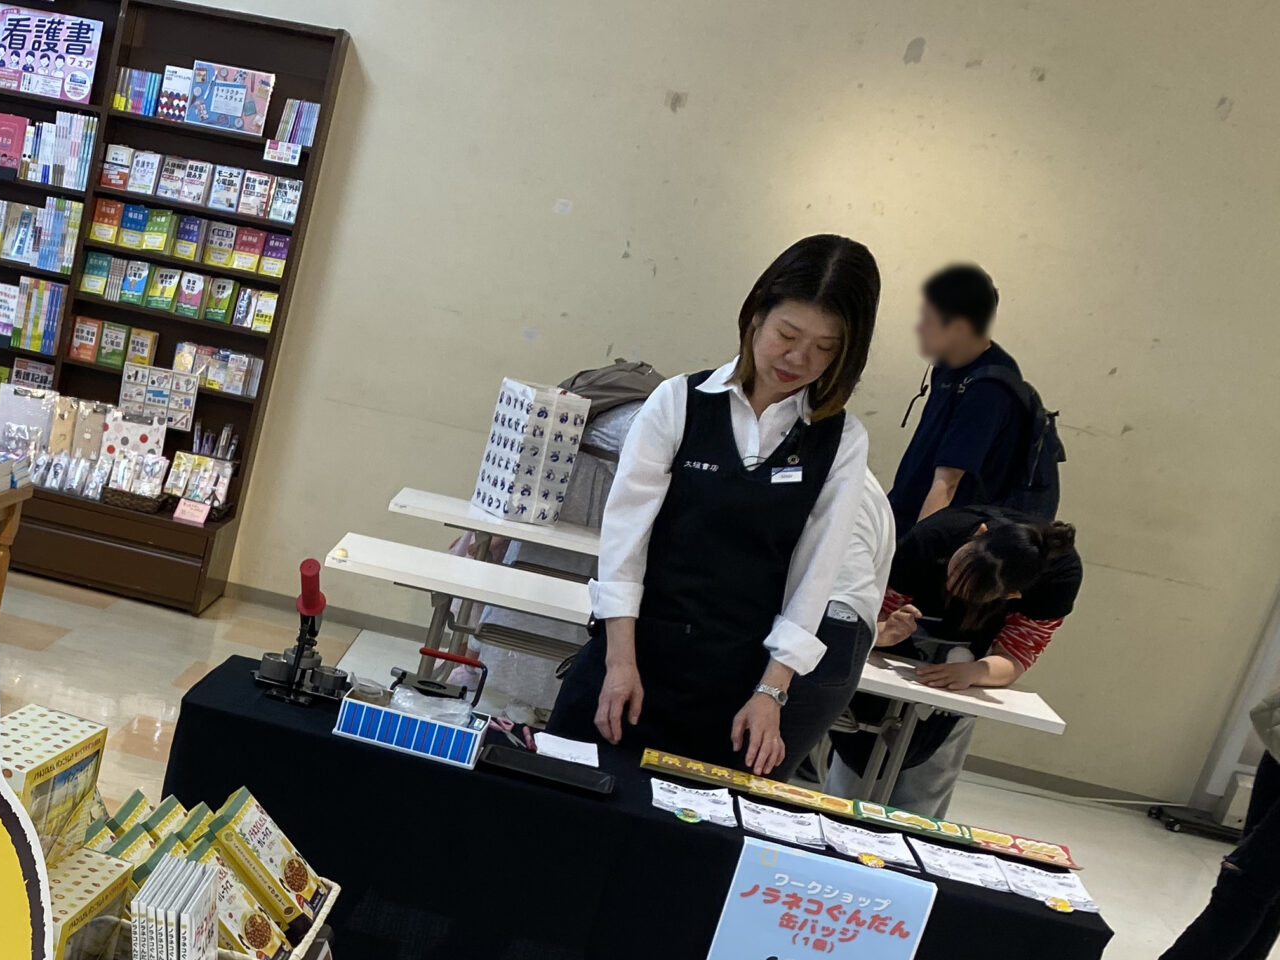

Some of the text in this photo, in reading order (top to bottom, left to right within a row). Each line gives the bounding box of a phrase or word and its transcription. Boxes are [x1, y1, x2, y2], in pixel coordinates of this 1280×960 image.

[1, 17, 95, 55] 看護書
[68, 57, 93, 69] フェア
[773, 873, 892, 911] ワークショップ
[739, 884, 911, 940] ノラネコぐんだん
[778, 912, 861, 944] 缶バッジ
